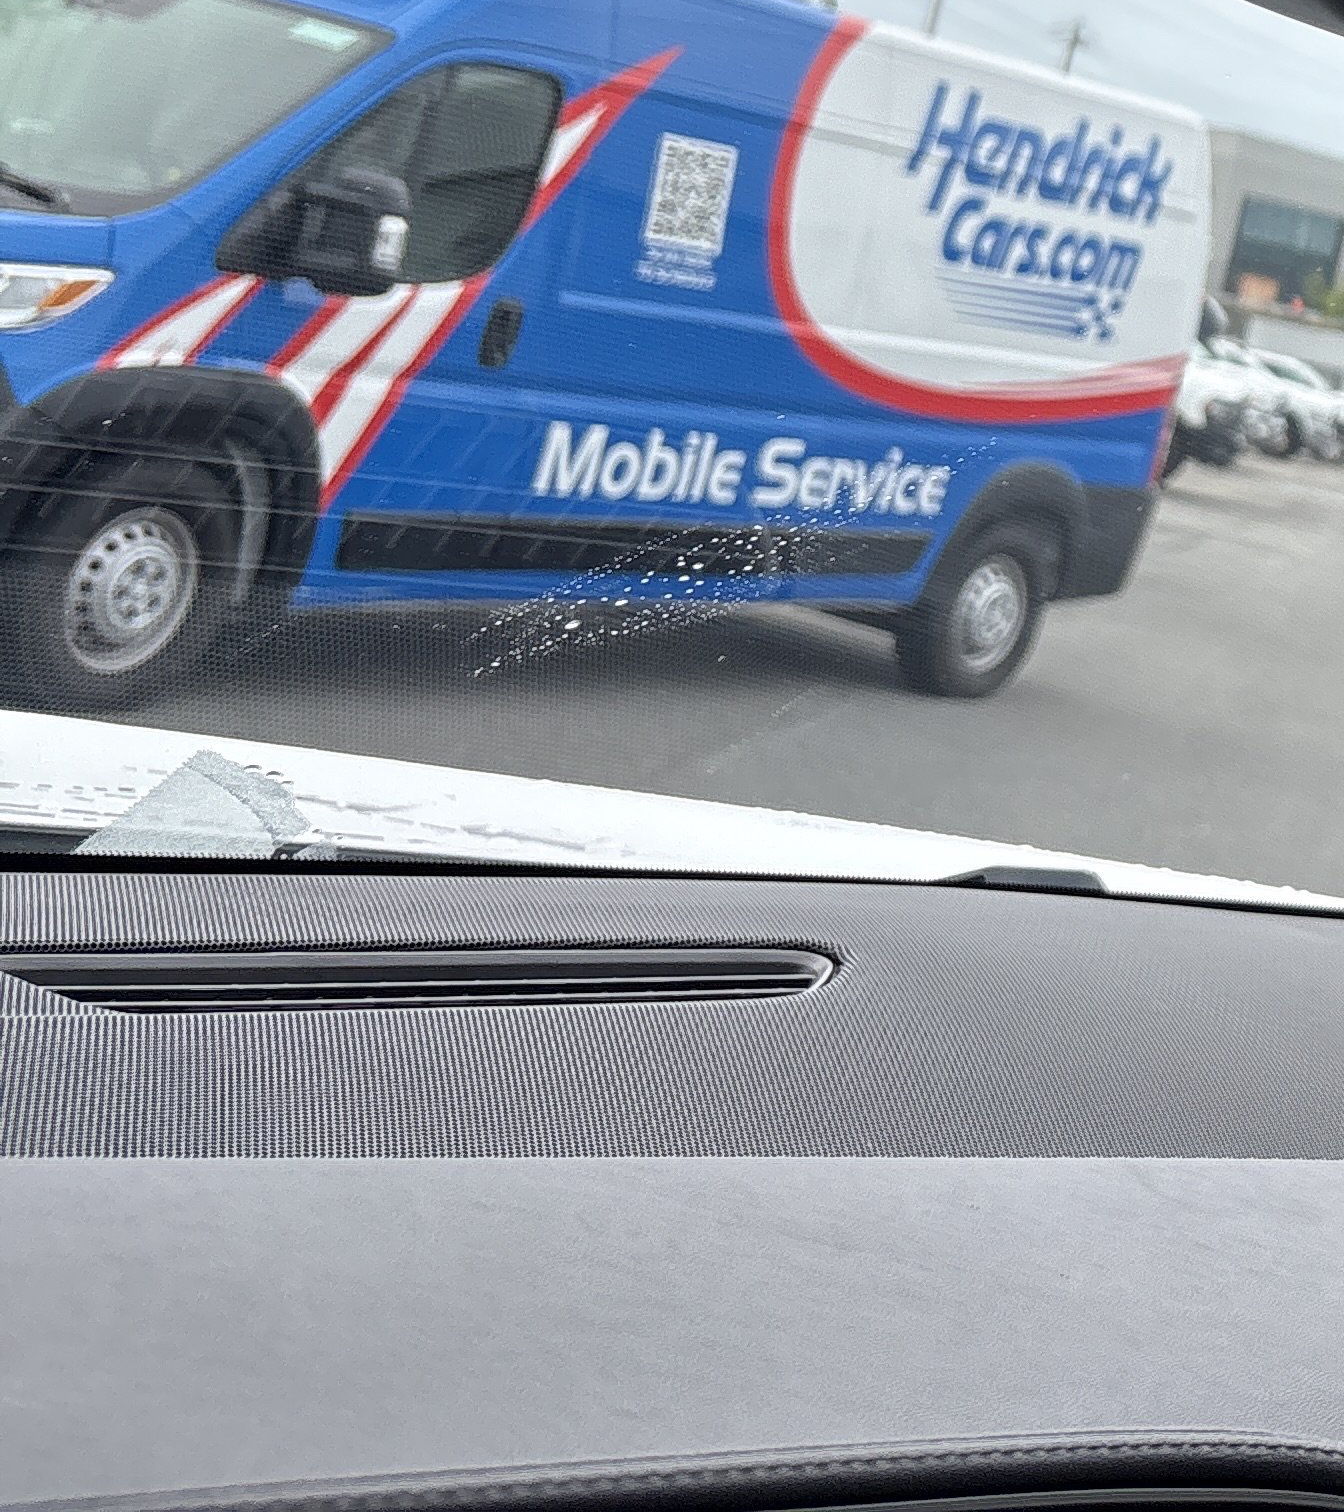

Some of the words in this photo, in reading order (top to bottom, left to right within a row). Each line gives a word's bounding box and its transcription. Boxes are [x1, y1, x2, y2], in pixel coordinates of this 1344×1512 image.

[906, 80, 1174, 226] Hendrick
[941, 194, 1143, 292] Cars.com
[532, 419, 748, 506] Mobile
[749, 436, 951, 517] Service
